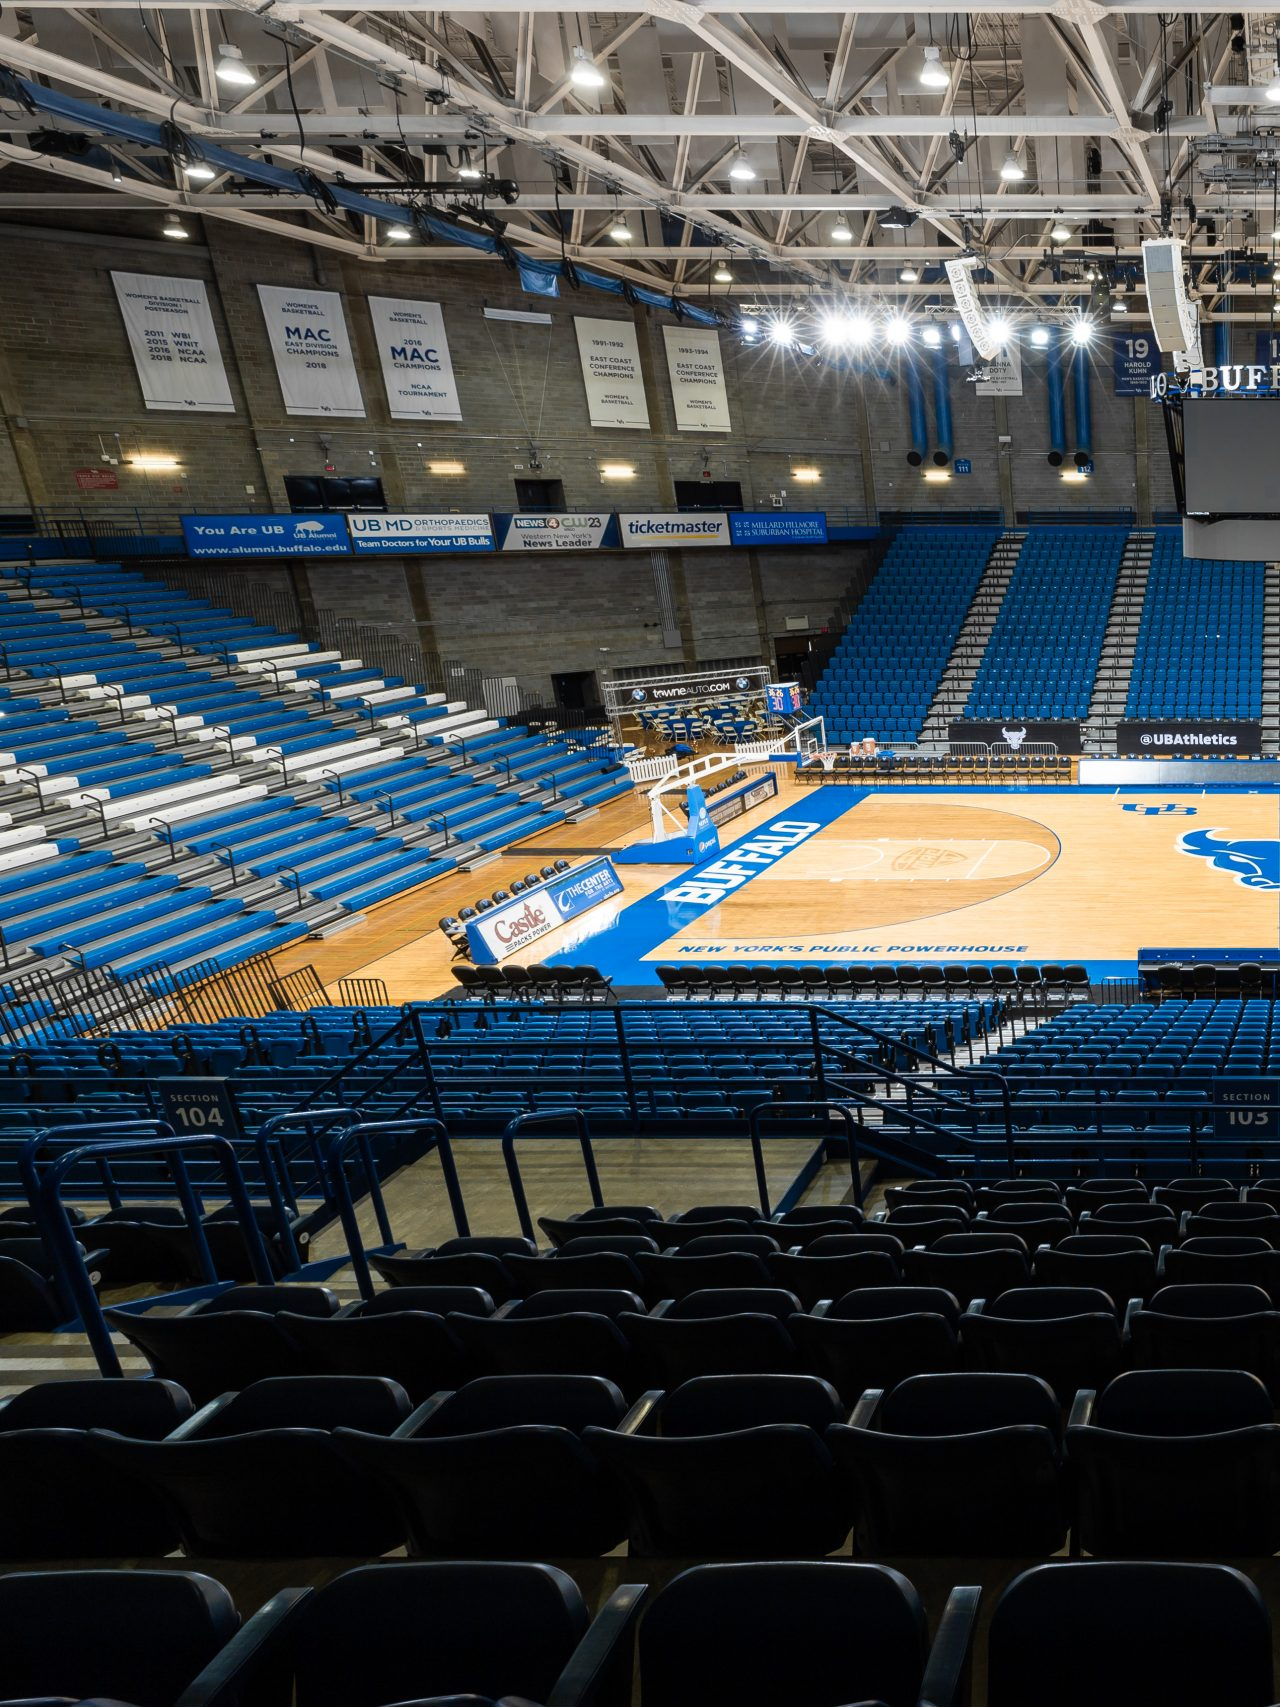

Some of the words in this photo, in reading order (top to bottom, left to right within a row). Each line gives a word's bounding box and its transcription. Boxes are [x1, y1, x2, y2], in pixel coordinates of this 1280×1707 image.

[282, 308, 325, 316] BASKETBALL
[389, 317, 427, 325] BASKETBALL
[285, 326, 331, 341] MAC
[592, 340, 624, 348] 1991-1992
[178, 348, 205, 356] NCAA
[287, 349, 339, 357] CHAMPIONS
[1125, 339, 1149, 359] 19
[391, 346, 439, 363] MAC
[180, 356, 207, 364] NCAA
[394, 363, 441, 371] CHAMPIONS
[589, 363, 635, 372] CONFERENCE
[593, 371, 634, 379] CHAMPIONS
[676, 370, 718, 378] CONFERENCE
[680, 377, 717, 385] CHAMPIONS
[353, 519, 381, 532] UB
[386, 519, 413, 531] MD
[516, 519, 545, 528] NEWS
[547, 518, 559, 528] 4
[588, 517, 601, 528] 23
[628, 520, 722, 534] ticketmaster
[751, 521, 784, 529] MILLARD
[785, 521, 819, 529] FILLMORE
[194, 526, 224, 535] You
[230, 526, 257, 535] Are
[261, 526, 284, 535] UB
[789, 528, 824, 536] HOSPITAL
[357, 540, 380, 548] Team
[382, 540, 414, 548] Doctors
[416, 538, 428, 547] for
[428, 537, 451, 547] Your
[453, 537, 467, 546] UB
[469, 536, 490, 546] Bulls
[524, 540, 553, 548] News
[193, 544, 347, 554] www.alumni.buffalo.edu
[653, 682, 730, 699] towneAUTO.COM
[1140, 734, 1238, 746] @UBAthletics
[1117, 803, 1198, 816] UB
[657, 820, 821, 905] BUFFALO
[494, 902, 546, 943] Castle
[514, 934, 533, 948] PACKS
[532, 922, 552, 939] POWER
[678, 945, 728, 953] NEW
[733, 945, 804, 953] YORK'S
[809, 945, 884, 953] PUBLIC
[887, 945, 1029, 953] POWERHOUSE
[170, 1094, 219, 1102] SECTION
[1223, 1093, 1270, 1101] SECTION
[176, 1107, 225, 1127] 104
